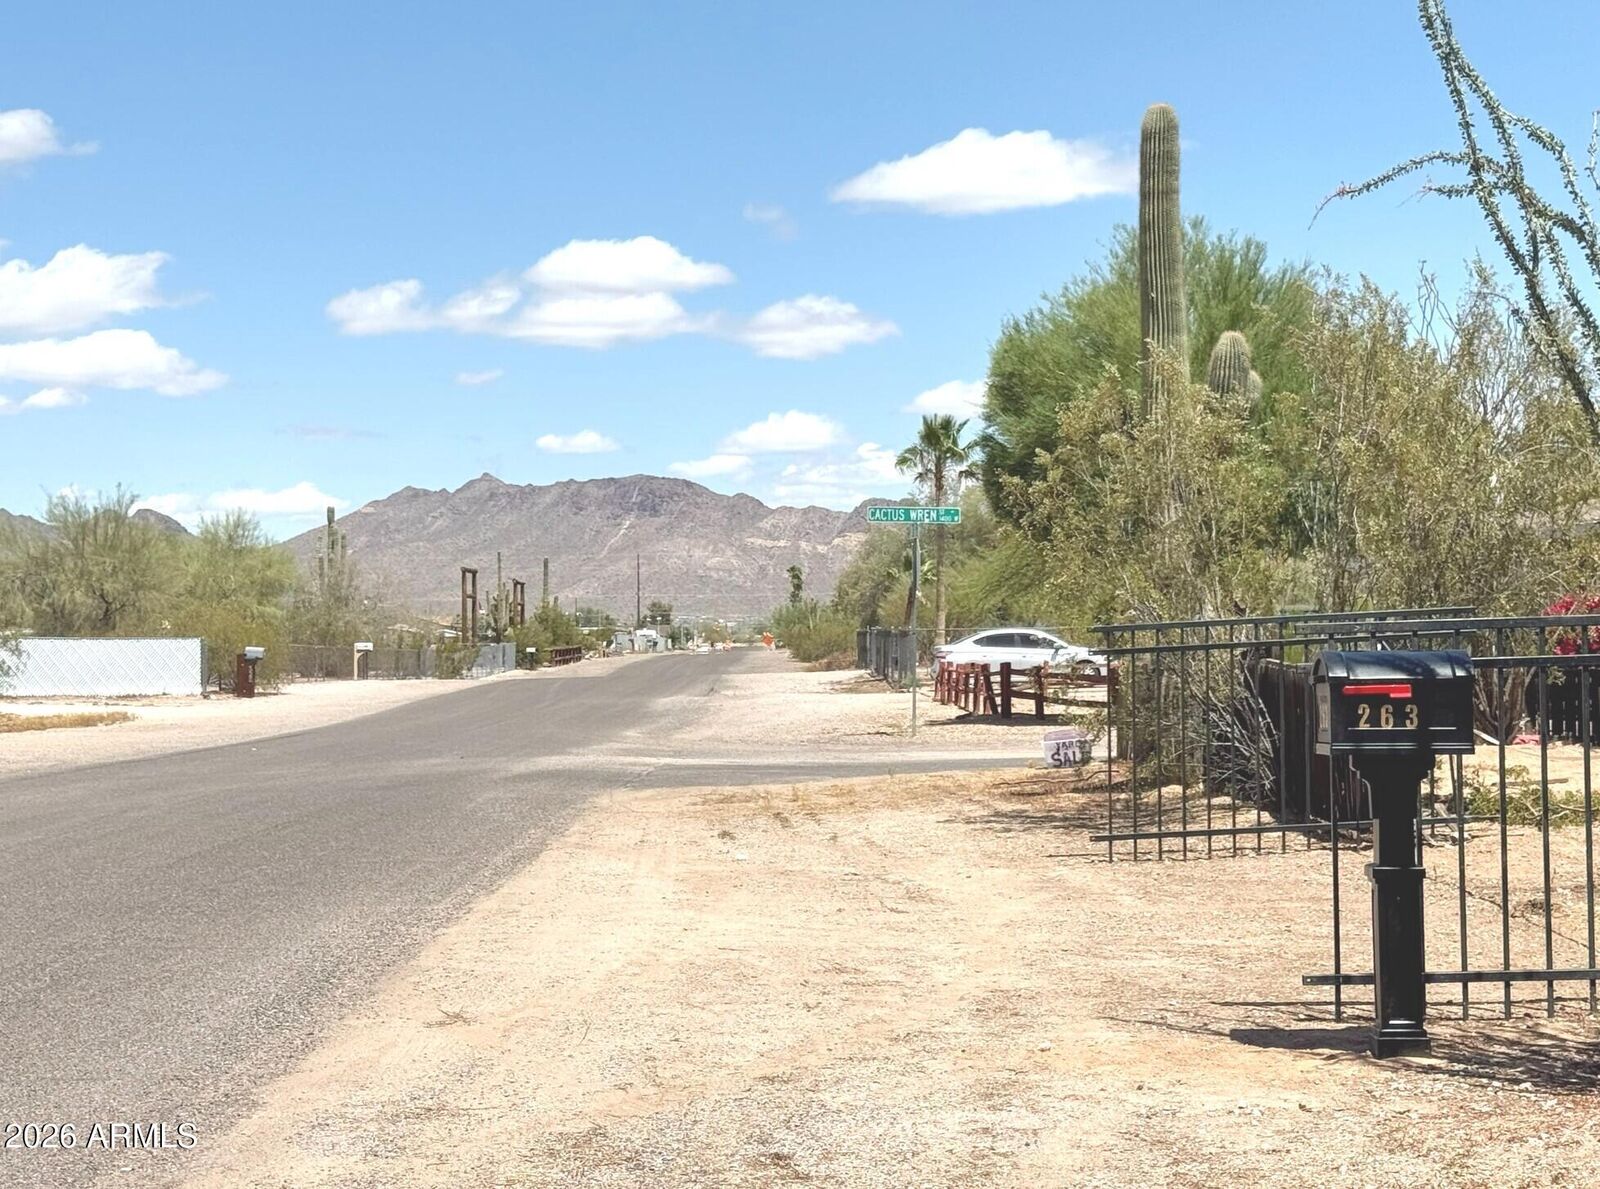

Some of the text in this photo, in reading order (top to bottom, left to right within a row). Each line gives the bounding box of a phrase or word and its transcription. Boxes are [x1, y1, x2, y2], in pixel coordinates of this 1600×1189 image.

[868, 508, 937, 521] CACTUS WREN
[1357, 703, 1419, 729] 263
